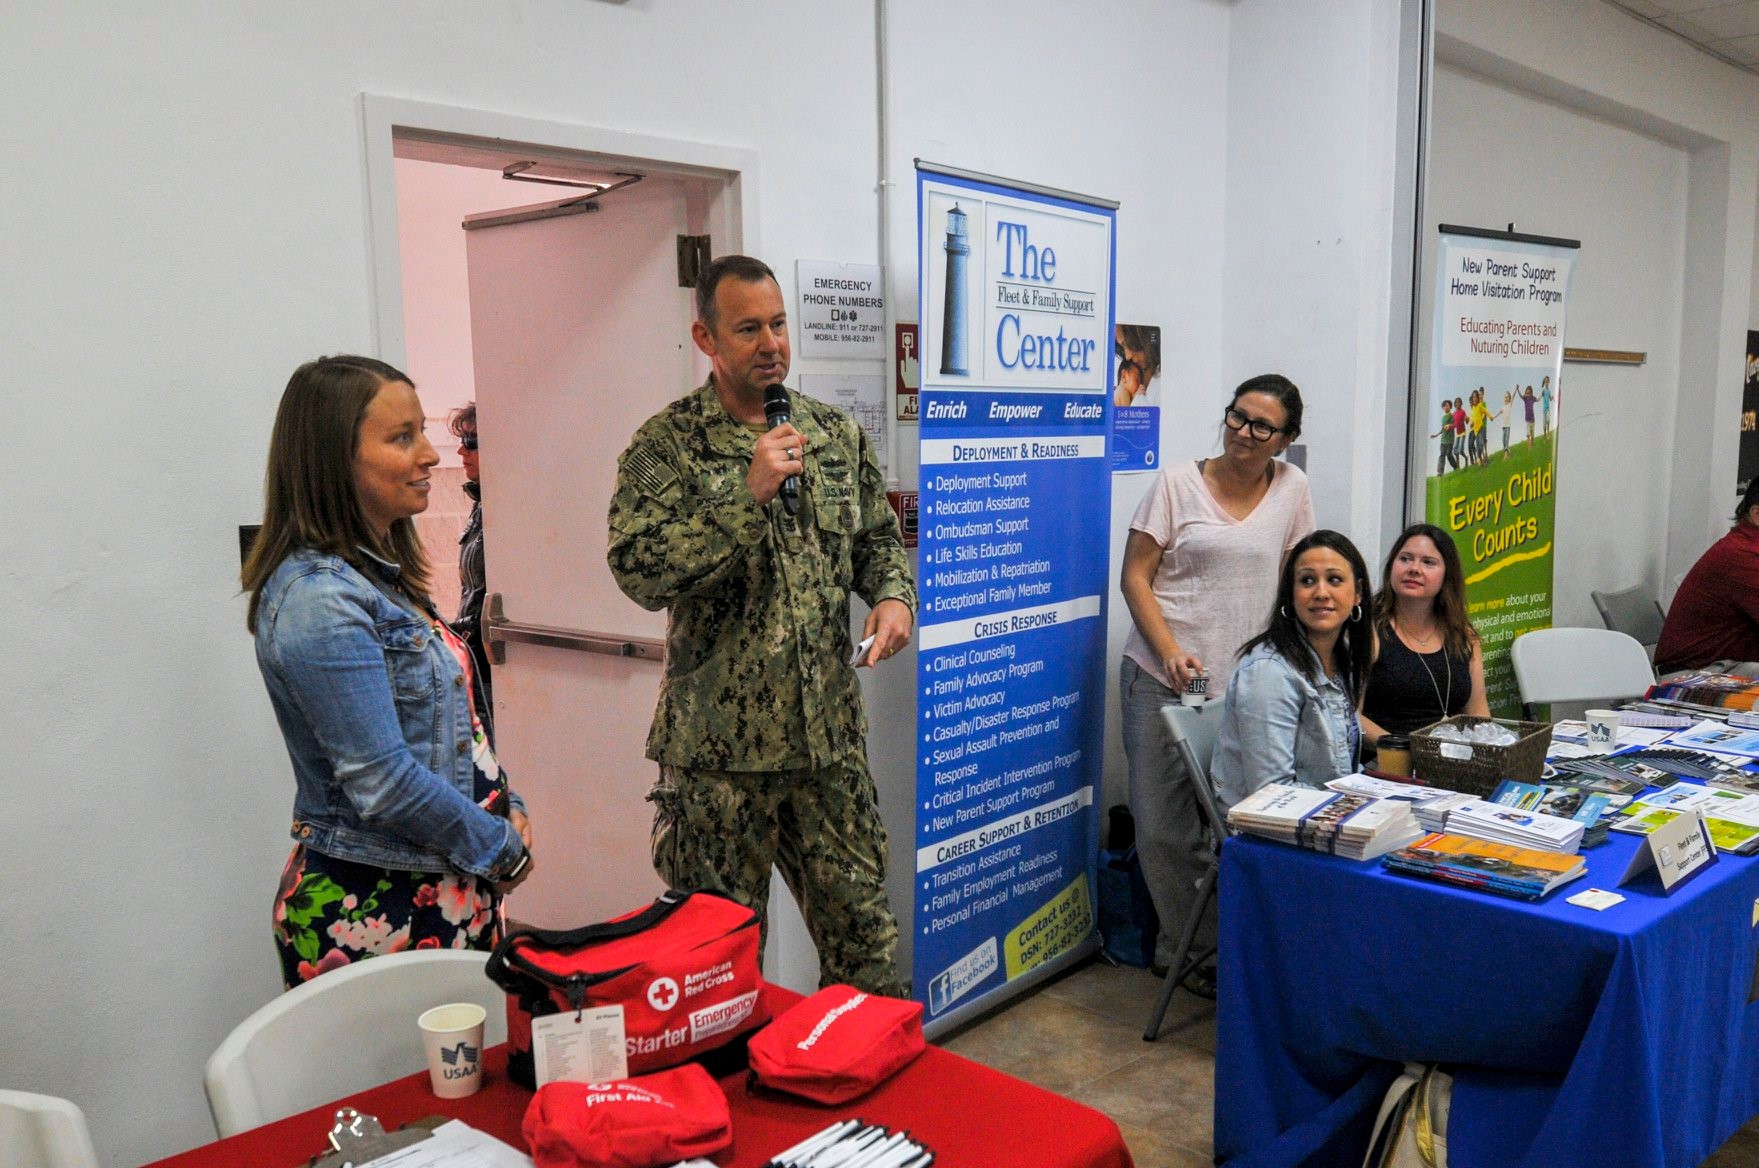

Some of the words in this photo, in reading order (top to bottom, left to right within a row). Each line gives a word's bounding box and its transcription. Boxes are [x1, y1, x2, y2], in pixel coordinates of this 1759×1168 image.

[997, 220, 1057, 282] The
[1462, 257, 1482, 275] New
[1487, 259, 1518, 278] Parent
[1522, 263, 1556, 284] Support
[814, 278, 872, 291] EMERGENCY
[1451, 278, 1478, 296] Home
[1482, 281, 1525, 300] Visitation
[1529, 286, 1562, 306] Program
[803, 294, 836, 305] PHONE
[839, 296, 883, 308] NUMBERS
[998, 286, 1020, 304] Fleet
[1022, 288, 1030, 304] &
[1032, 290, 1062, 310] Family
[1063, 294, 1094, 314] Support
[804, 322, 838, 331] LANDLINE:
[858, 324, 883, 332] 727-2911
[814, 333, 840, 341] MOBILE:
[841, 334, 875, 342] 956-82-2911
[1460, 317, 1505, 339] Educating
[1507, 320, 1541, 336] Parents
[1543, 323, 1557, 337] and
[996, 313, 1095, 371] Center
[1470, 338, 1508, 358] Nuturing
[1511, 339, 1549, 355] Children
[904, 405, 918, 414] ALA
[926, 401, 967, 419] Enrich
[989, 402, 1042, 422] Empower
[1064, 403, 1102, 418] Educate
[953, 444, 1017, 461] DEPLOYMENT
[1020, 444, 1029, 458] &
[1032, 443, 1079, 458] READINESS
[936, 474, 991, 493] Deployment
[993, 472, 1027, 491] Support
[903, 496, 918, 508] FIR
[936, 499, 982, 515] Relocation
[986, 497, 1030, 511] Assistance
[1450, 487, 1504, 531] Every
[1507, 463, 1552, 508] Child
[935, 523, 993, 539] Ombudsman
[996, 517, 1029, 536] Support
[1474, 516, 1538, 562] Counts
[935, 548, 952, 564] Life
[955, 545, 978, 561] Skills
[980, 541, 1022, 559] Education
[935, 568, 989, 588] Mobilization
[991, 565, 998, 579] &
[1001, 559, 1050, 580] Repatriation
[935, 591, 986, 612] Exceptional
[989, 586, 1016, 604] Family
[1018, 581, 1052, 597] Member
[1486, 598, 1505, 610] more
[1506, 594, 1528, 607] about
[1529, 592, 1547, 605] your
[974, 620, 1008, 638] CRISIS
[1011, 611, 1057, 630] RESPONSE
[1472, 613, 1499, 630] physical
[1500, 611, 1515, 624] and
[1516, 607, 1551, 621] emotiona
[1490, 629, 1504, 642] and
[1505, 630, 1513, 641] to
[934, 655, 967, 672] Clinical
[969, 643, 1016, 665] Counseling
[934, 677, 963, 695] Family
[966, 668, 1006, 688] Advocacy
[1009, 659, 1043, 678] Program
[934, 702, 962, 719] Victim
[965, 690, 1005, 710] Advocacy
[934, 711, 1010, 742] Casualty/Disaster
[1012, 700, 1050, 720] Response
[1052, 690, 1079, 709] Program
[933, 743, 963, 765] Sexual
[966, 735, 998, 755] Assault
[1000, 722, 1042, 744] Prevention
[1045, 716, 1059, 732] and
[1591, 735, 1609, 743] USAA
[933, 789, 963, 809] Critical
[966, 776, 1001, 799] Incident
[1004, 760, 1052, 786] Intervention
[1054, 749, 1081, 768] Program
[935, 763, 978, 786] Response
[933, 817, 953, 832] New
[956, 805, 985, 823] Parent
[986, 791, 1019, 813] Support
[1021, 780, 1055, 801] Program
[937, 839, 975, 863] CAREER
[978, 821, 1021, 848] SUPPORT
[1023, 815, 1031, 831] &
[1034, 799, 1079, 826] RETENTION
[932, 860, 976, 888] Transition
[978, 844, 1021, 871] Assistance
[932, 889, 961, 911] Family
[964, 867, 1016, 898] Employment
[1018, 850, 1058, 875] Readiness
[932, 907, 970, 934] Personal
[973, 887, 1008, 914] Financial
[1012, 867, 1063, 898] Management
[1019, 908, 1057, 947] Contact
[1059, 898, 1070, 914] us
[1072, 887, 1080, 904] @
[950, 961, 968, 981] Find
[970, 955, 979, 967] us
[981, 944, 991, 959] on
[1021, 941, 1042, 965] DSN:
[685, 961, 732, 986] American
[685, 982, 704, 998] Red
[705, 971, 734, 989] Cross
[951, 956, 996, 994] Facebook
[694, 996, 755, 1028] Emergency
[626, 1026, 688, 1056] Starter
[443, 1064, 477, 1080] USAA
[586, 1093, 622, 1108] First
